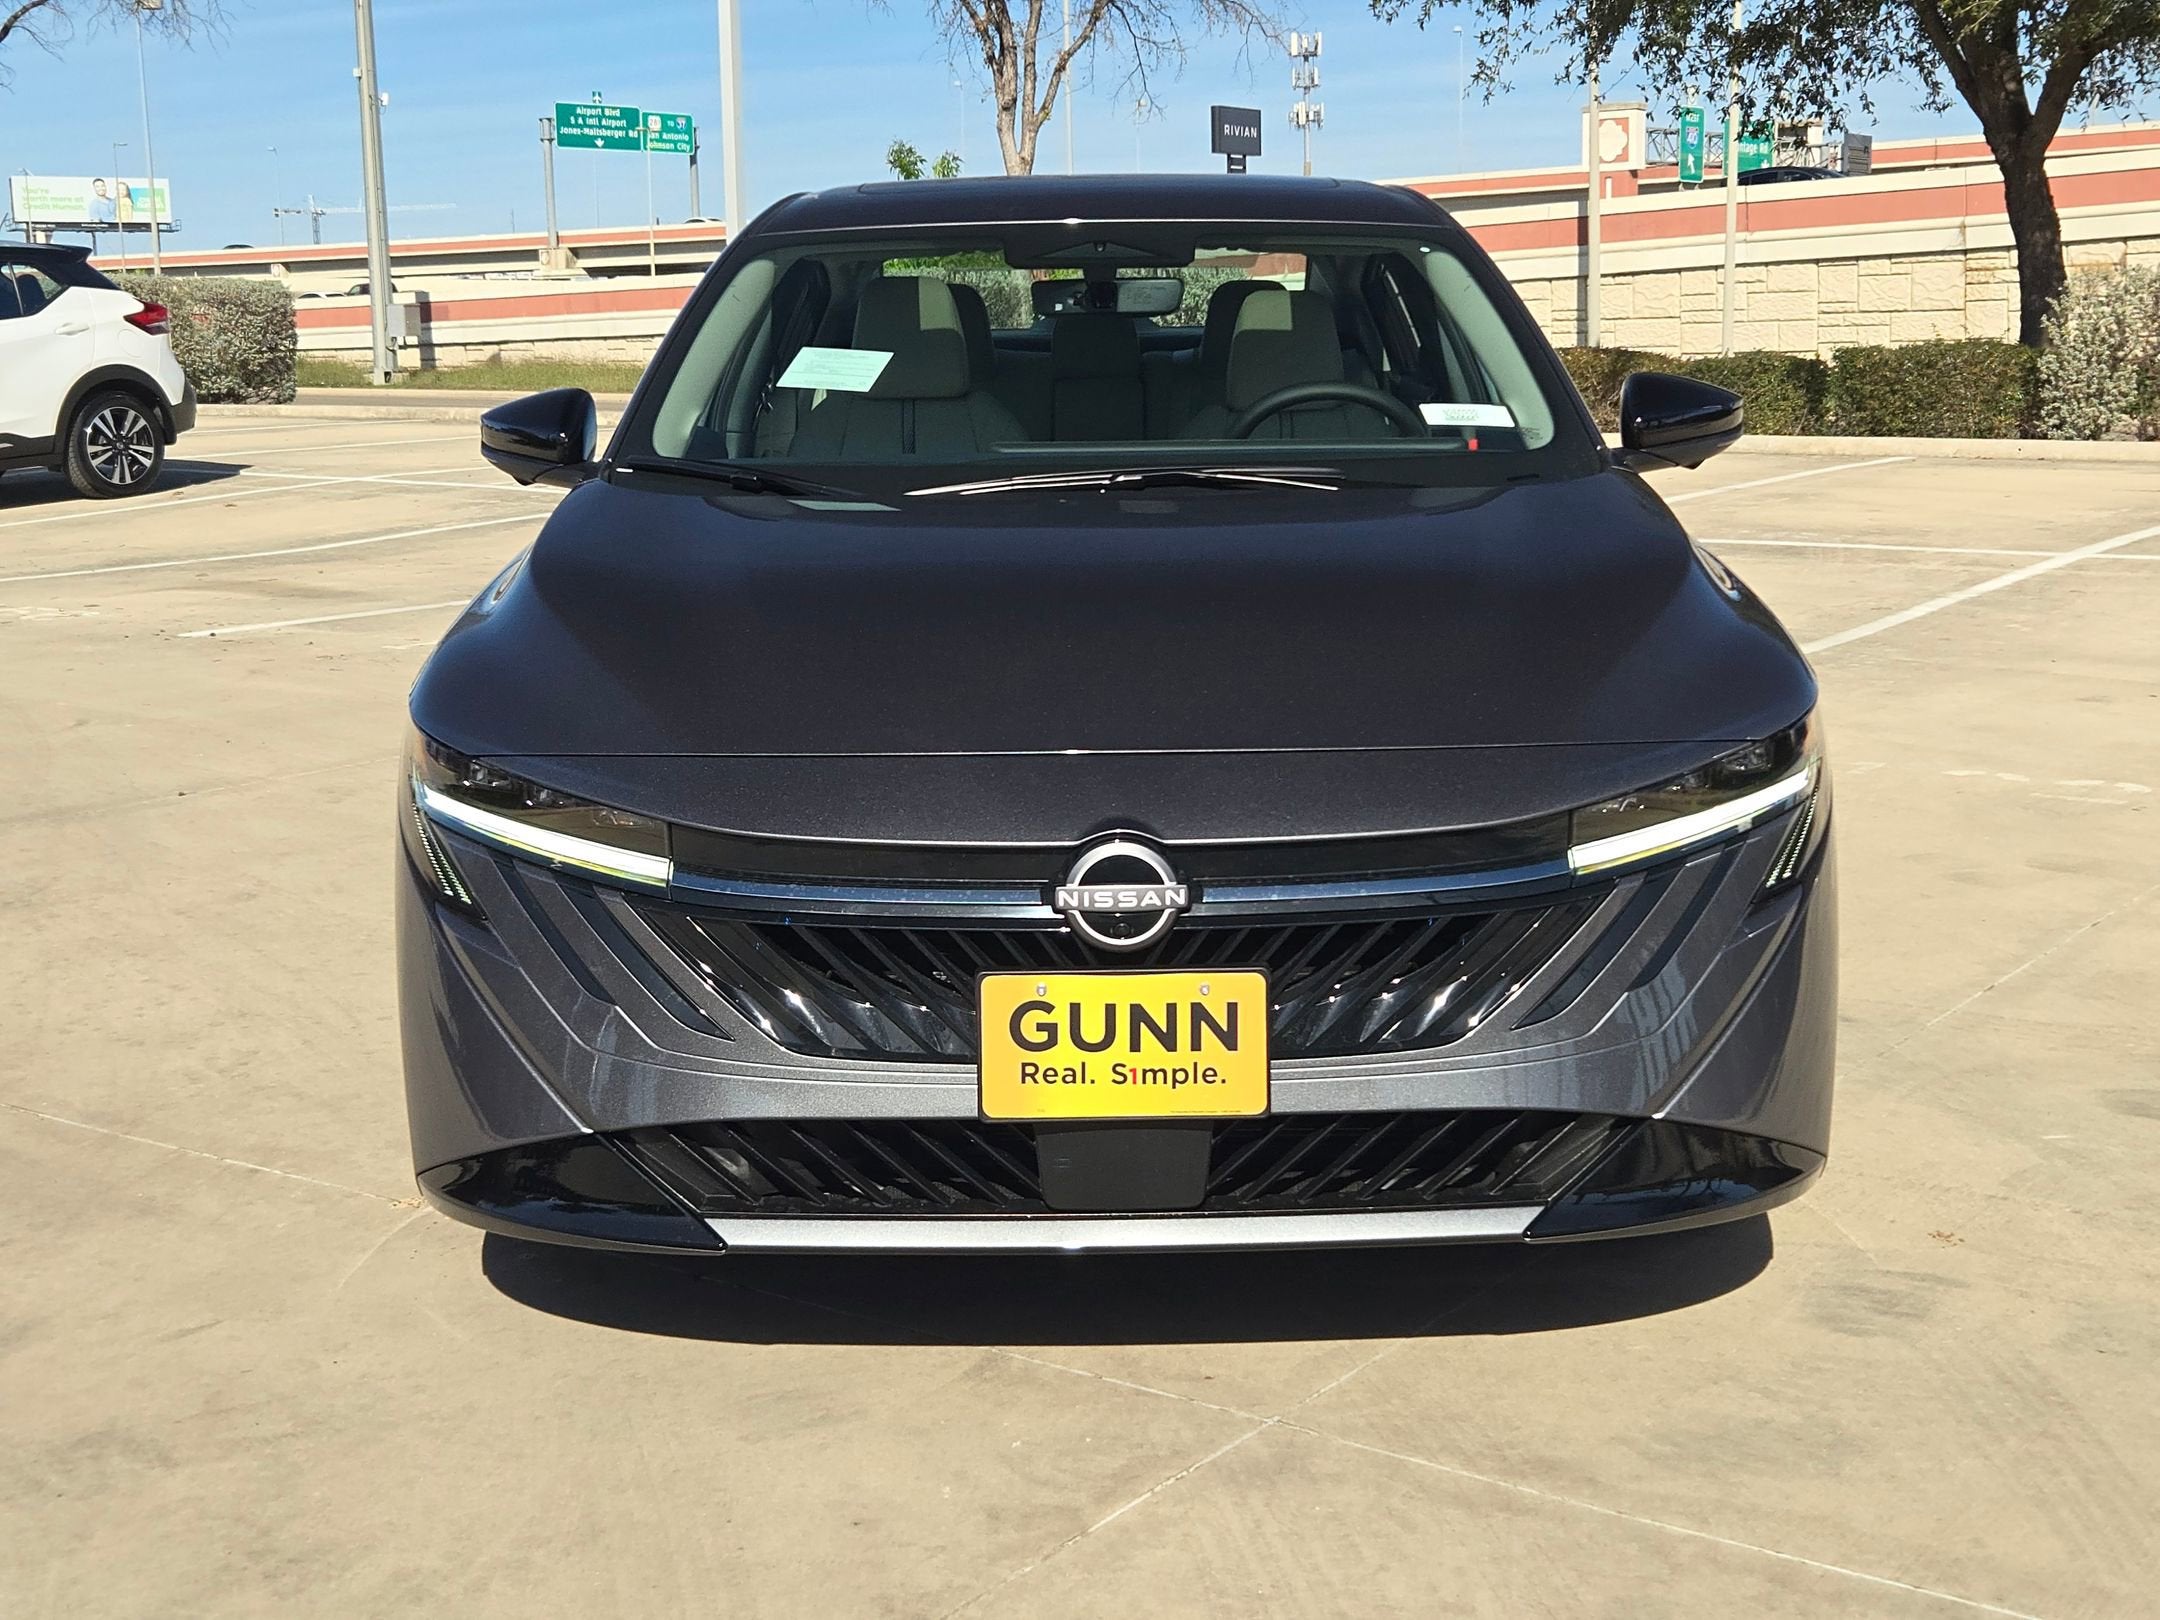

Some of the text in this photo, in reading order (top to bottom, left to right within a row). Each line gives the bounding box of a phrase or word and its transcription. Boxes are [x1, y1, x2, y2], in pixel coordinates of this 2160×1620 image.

[576, 106, 621, 117] Airport Blvd
[570, 116, 576, 124] S
[577, 117, 584, 125] A
[601, 118, 627, 128] Airport
[559, 126, 639, 139] Jones-Maltsberger Rd
[662, 132, 690, 142] Antonio
[1224, 124, 1257, 138] RIVIAN
[677, 142, 691, 152] City
[1058, 888, 1186, 909] NISSAN
[1009, 1000, 1239, 1053] GUNN
[1020, 1062, 1227, 1089] Real. S1mple.
